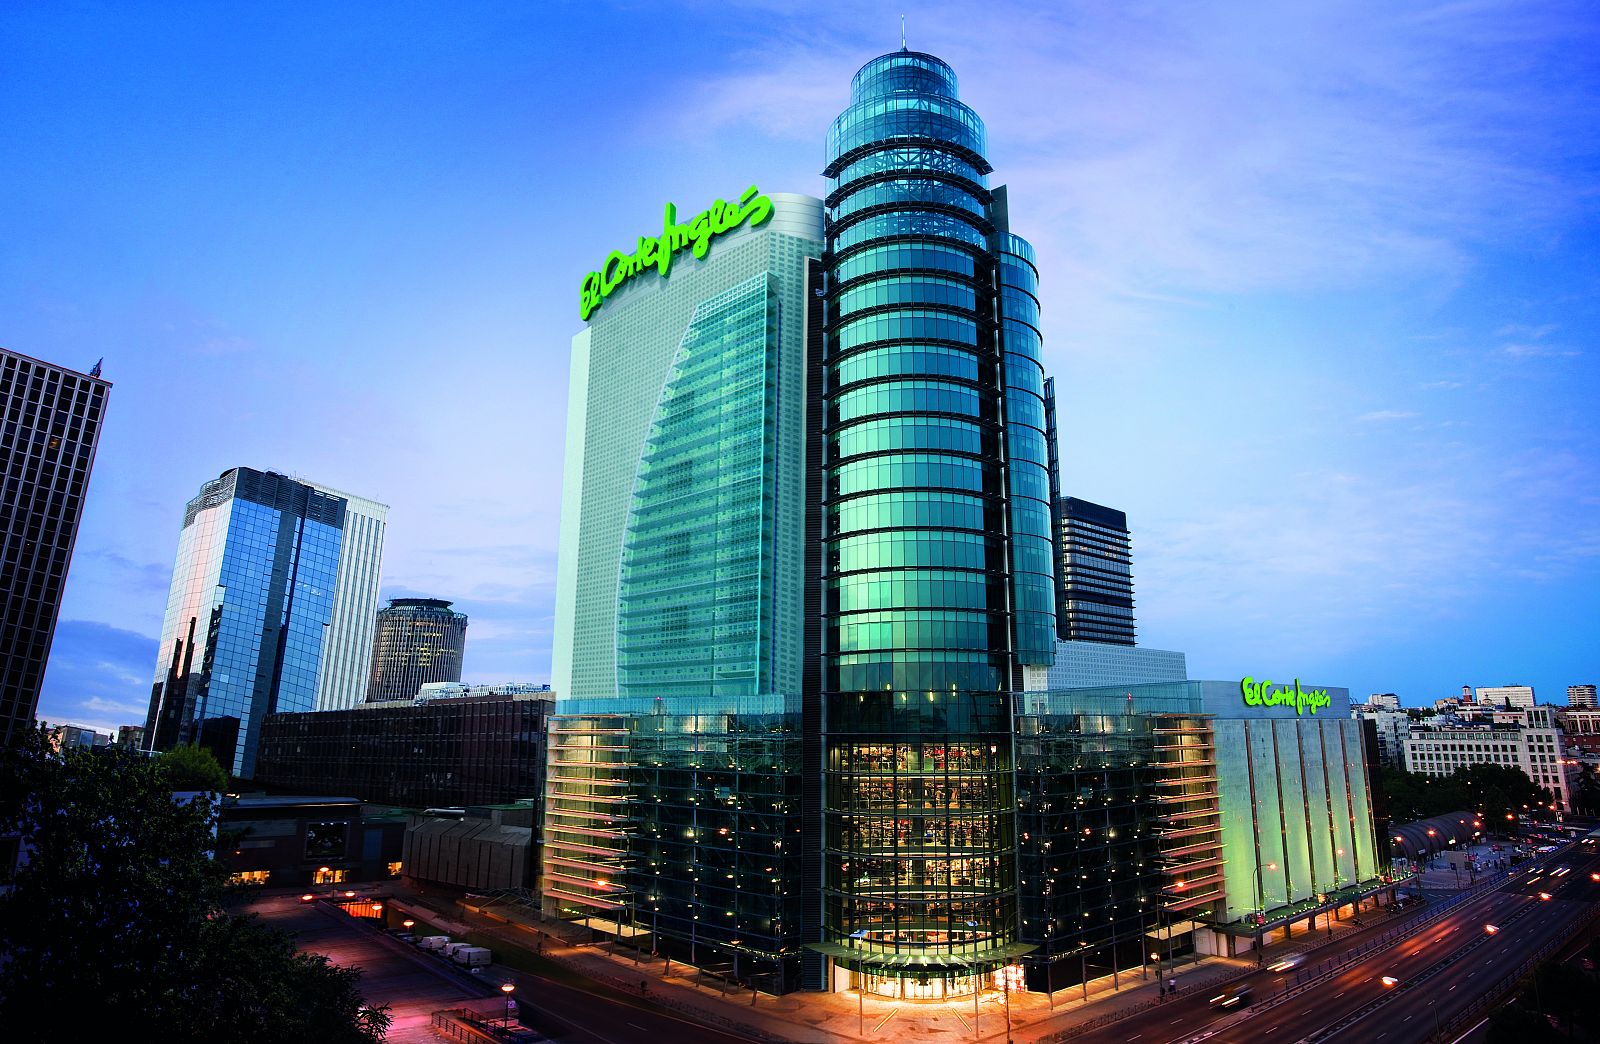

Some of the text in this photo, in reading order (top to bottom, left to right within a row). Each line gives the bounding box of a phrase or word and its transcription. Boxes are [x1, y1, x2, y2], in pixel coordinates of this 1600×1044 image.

[579, 184, 775, 321] El Corte Inglés
[1241, 676, 1331, 715] El Corte Inglés
